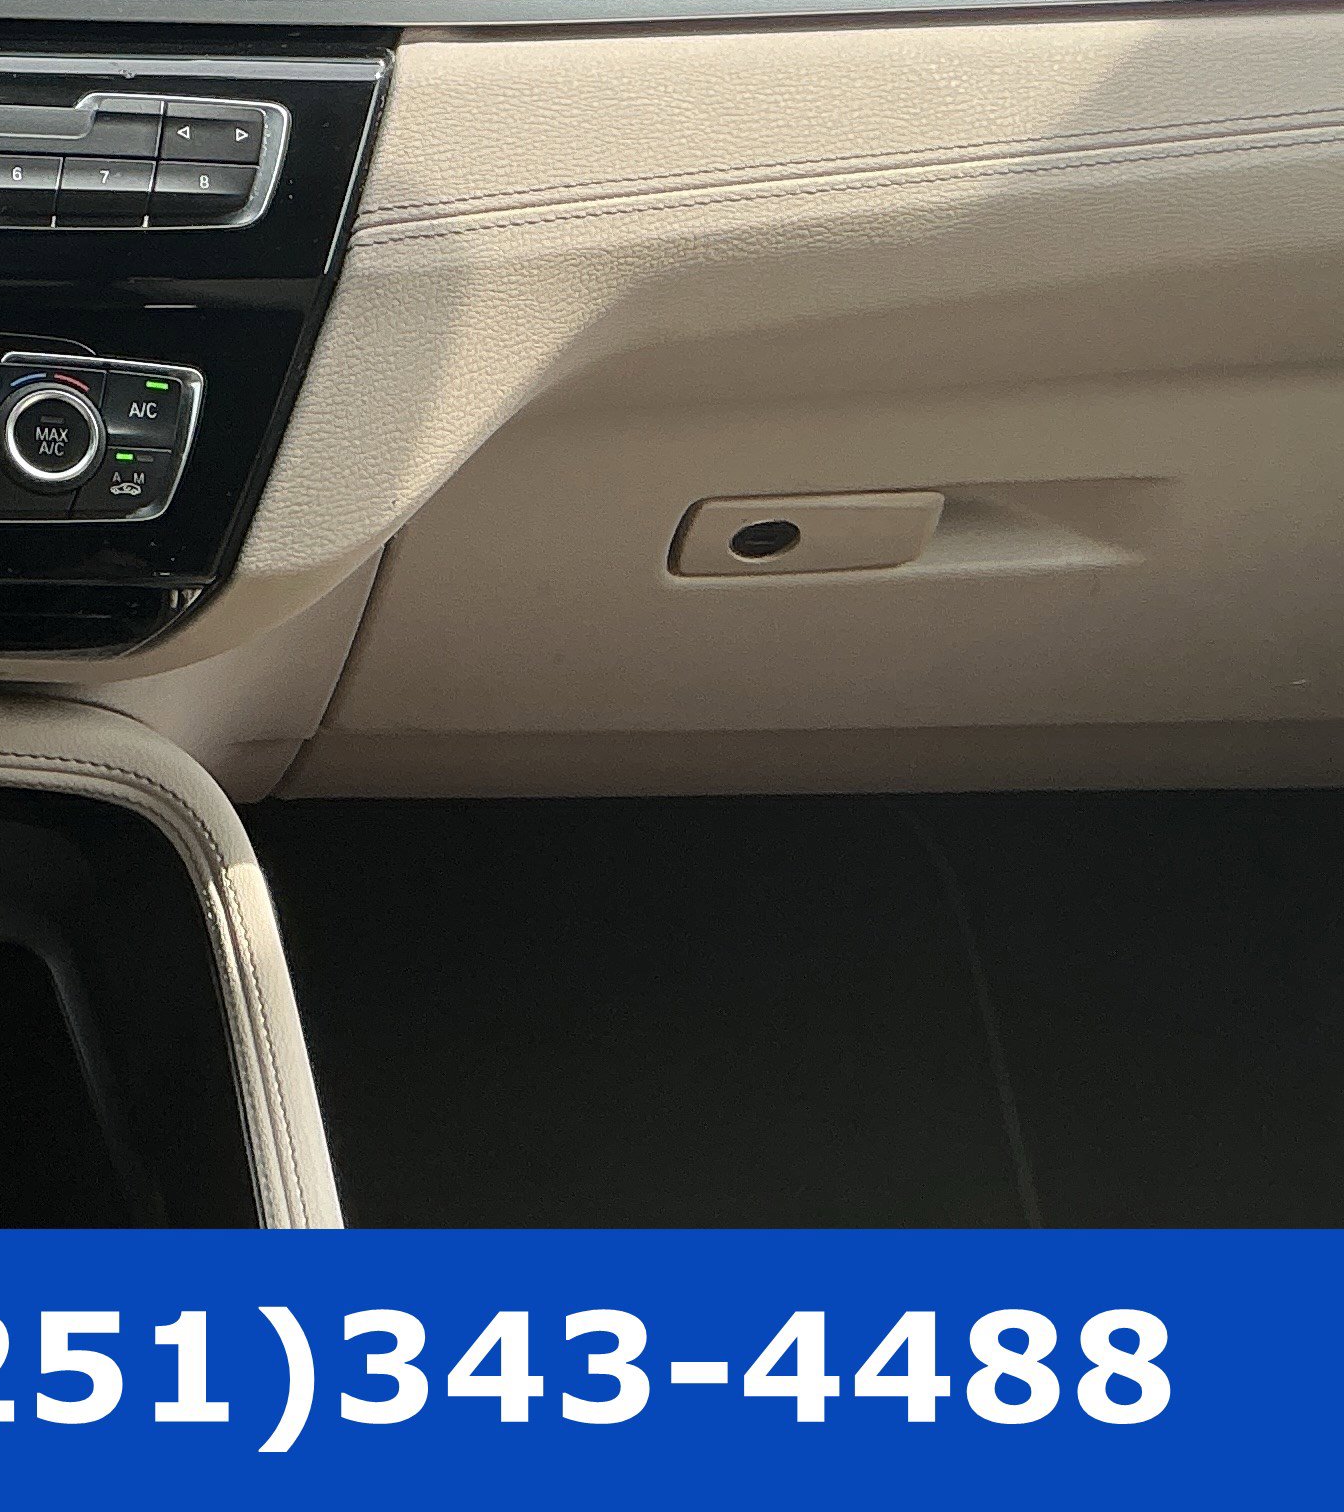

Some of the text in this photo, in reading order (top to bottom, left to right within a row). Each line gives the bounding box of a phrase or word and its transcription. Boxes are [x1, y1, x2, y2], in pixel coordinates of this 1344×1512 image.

[12, 166, 23, 182] 6
[99, 169, 110, 185] 7
[199, 174, 210, 190] 8
[128, 402, 158, 419] A/C
[35, 426, 69, 443] MAX
[38, 441, 65, 457] A/C
[112, 472, 122, 484] A
[132, 471, 145, 484] M
